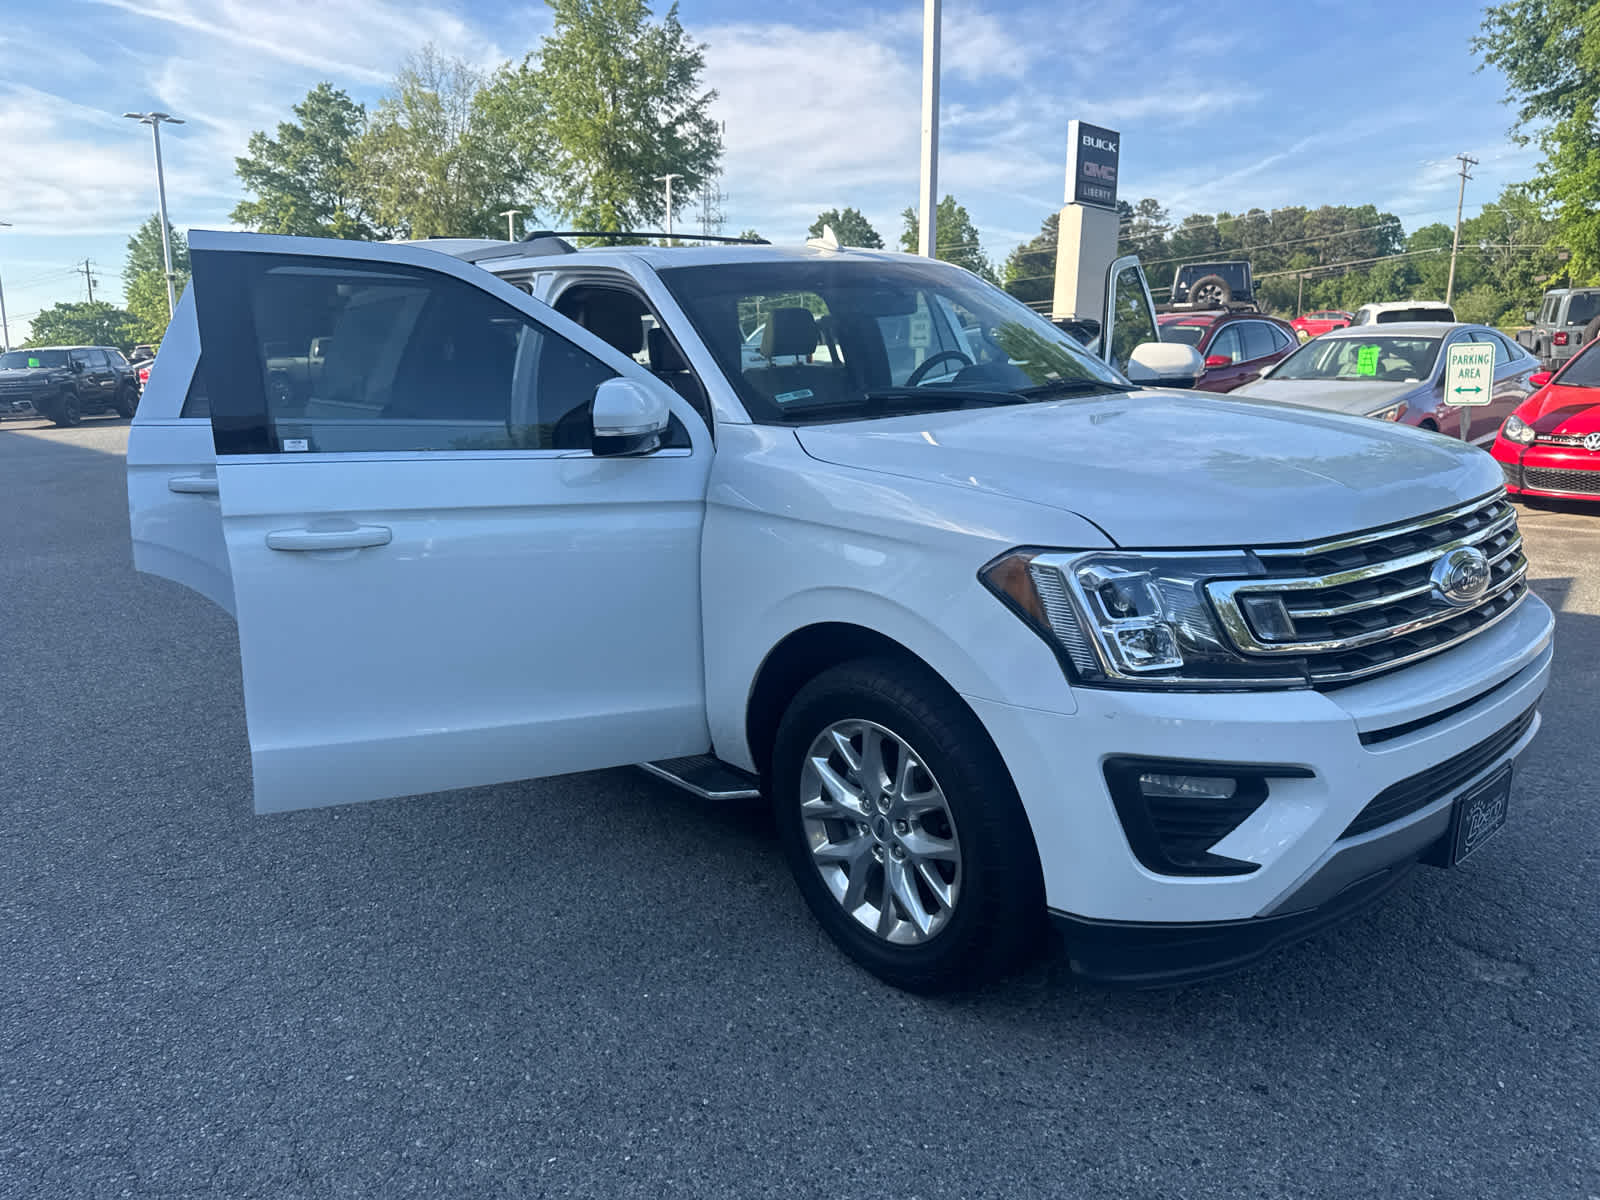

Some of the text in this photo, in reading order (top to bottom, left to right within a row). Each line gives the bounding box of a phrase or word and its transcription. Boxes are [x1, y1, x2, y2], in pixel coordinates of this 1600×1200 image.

[1082, 135, 1117, 153] BUICK
[1083, 161, 1116, 180] GMC
[1083, 184, 1110, 200] LIBERTY
[1452, 354, 1489, 365] PARKING
[1458, 368, 1481, 379] AREA
